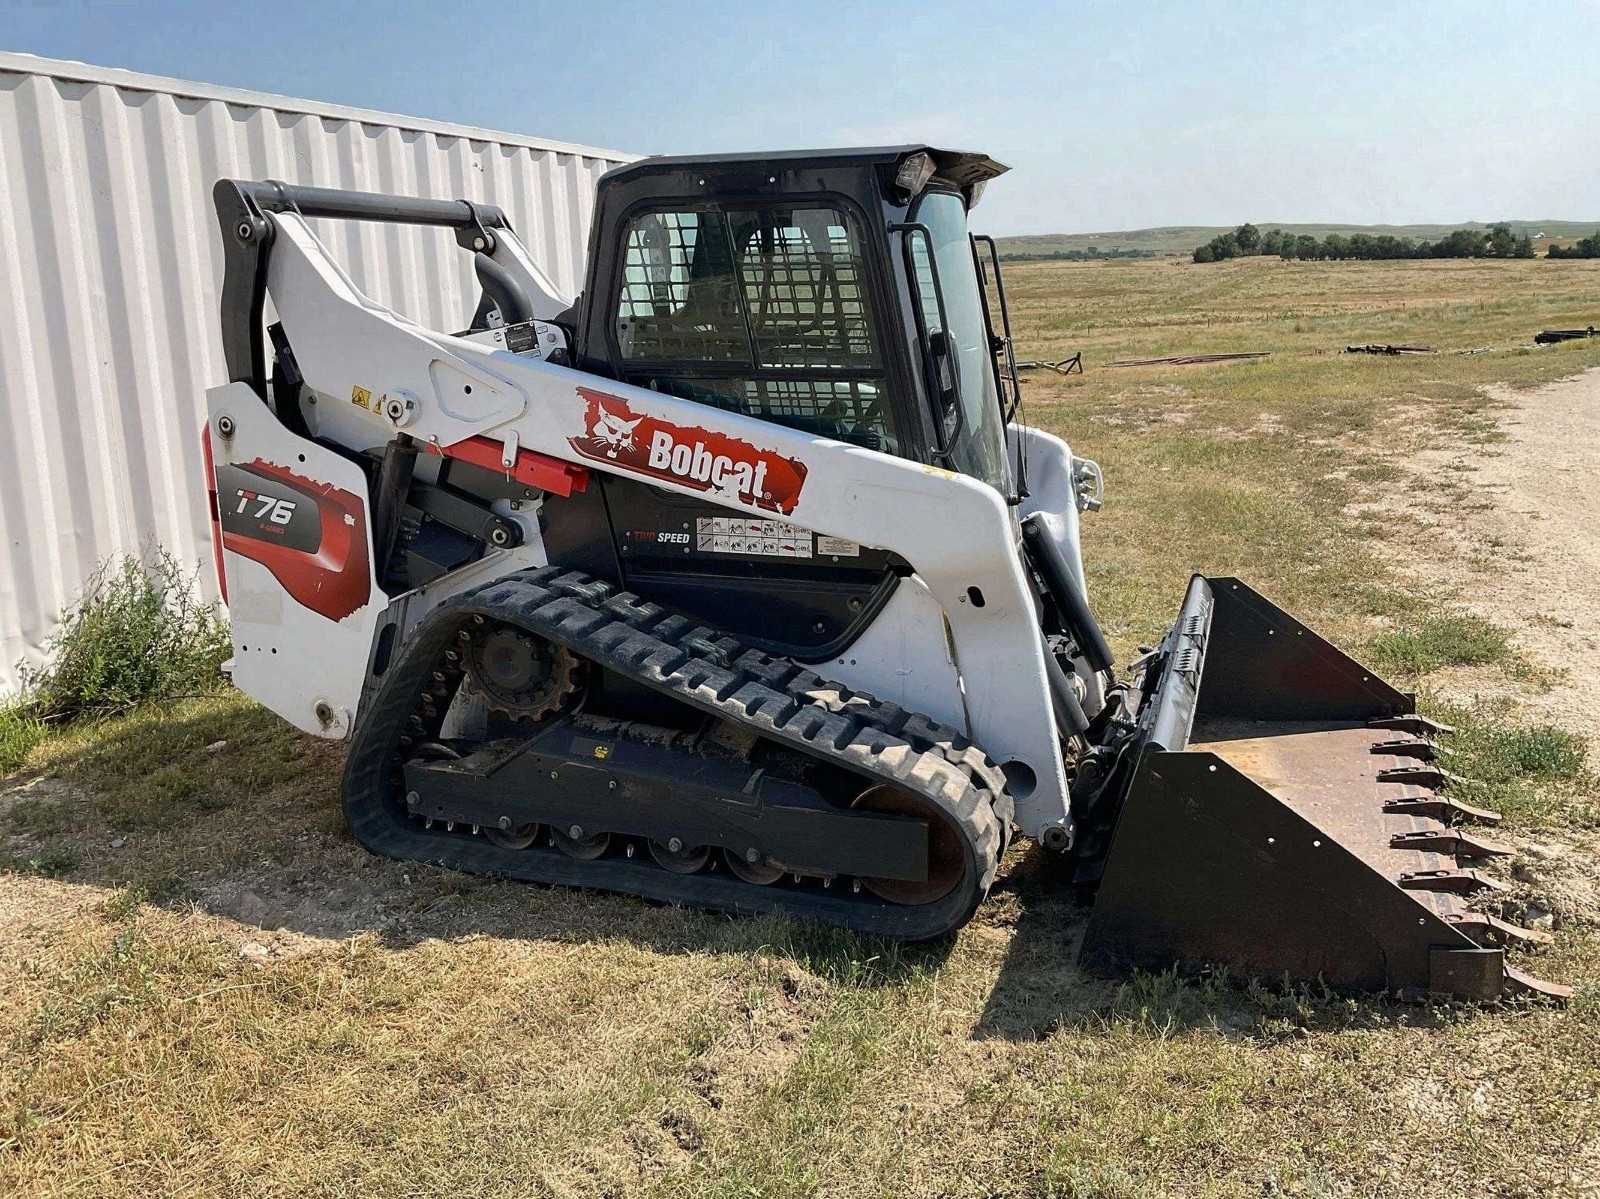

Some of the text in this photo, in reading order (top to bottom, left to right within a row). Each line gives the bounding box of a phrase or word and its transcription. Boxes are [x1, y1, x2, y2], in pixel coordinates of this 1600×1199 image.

[648, 430, 767, 498] Bobcat
[236, 489, 297, 525] T76
[633, 531, 690, 544] TWO SPEED
